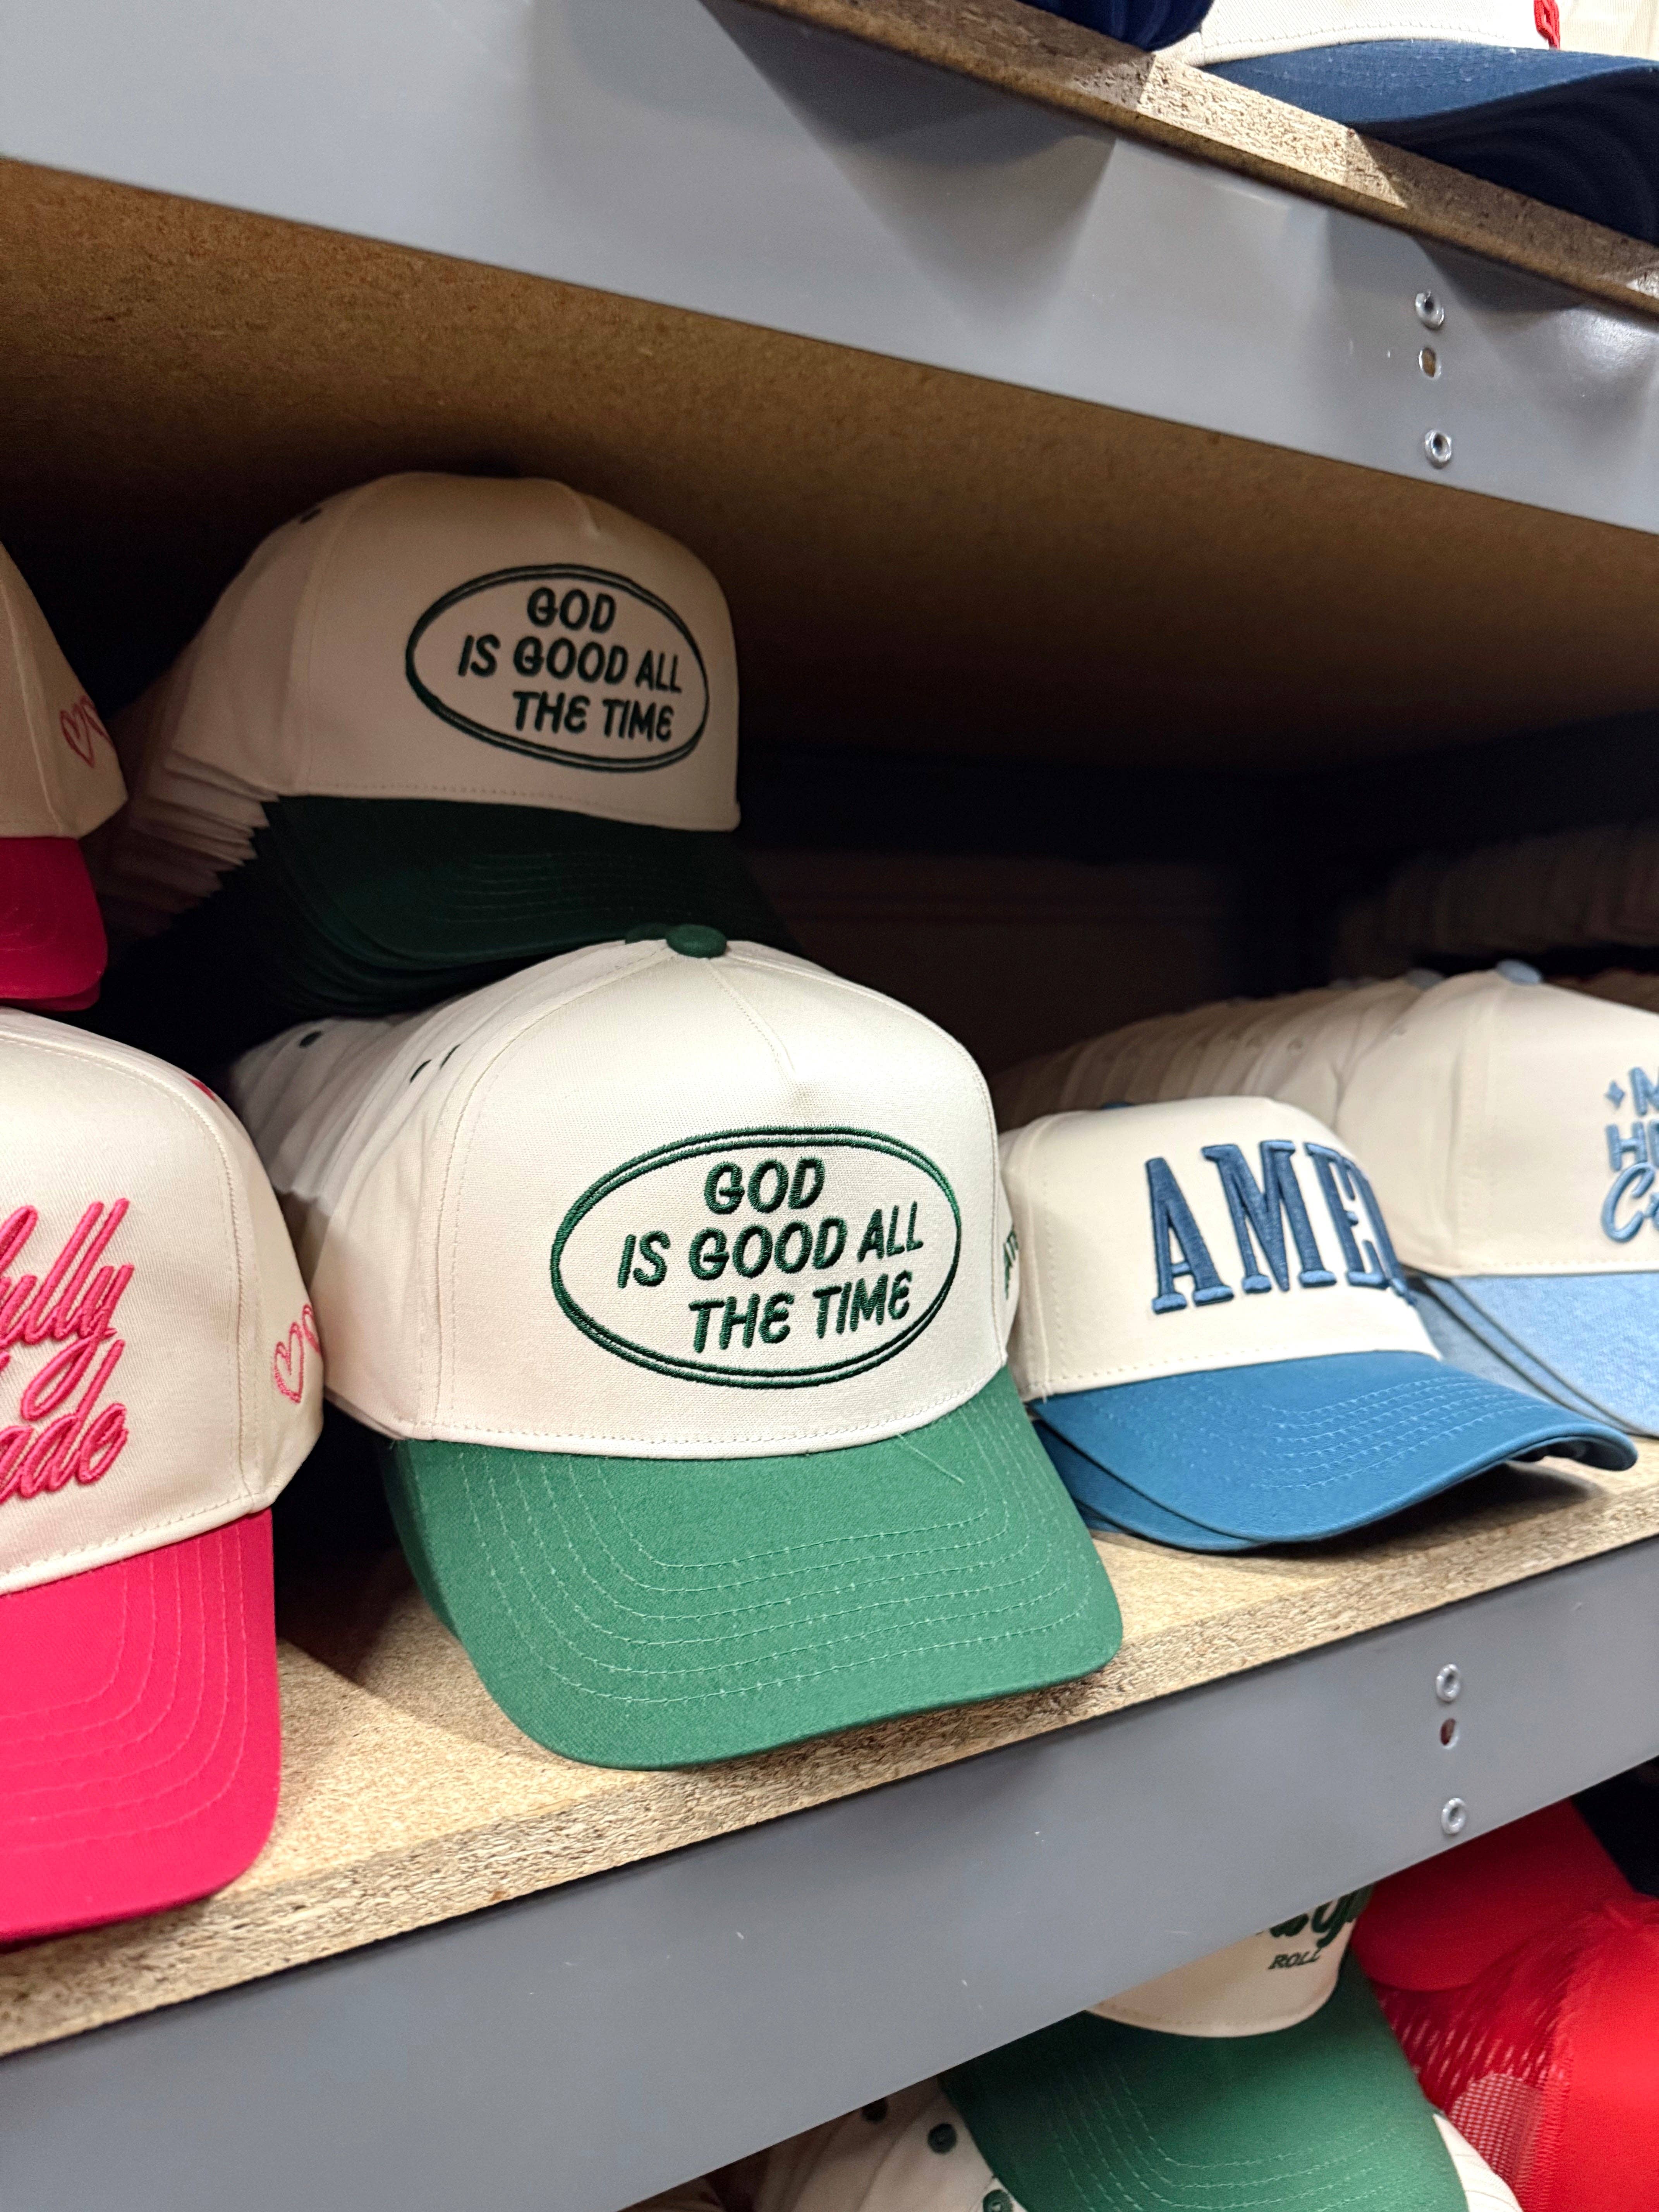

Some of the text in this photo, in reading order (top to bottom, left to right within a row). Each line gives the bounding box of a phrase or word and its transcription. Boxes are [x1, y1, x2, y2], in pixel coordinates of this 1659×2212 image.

[526, 586, 617, 634] GOD
[457, 634, 683, 694] IS GOOD ALL
[512, 690, 675, 742] THE TIME
[704, 1157, 826, 1216] GOD
[617, 1201, 924, 1289] IS GOOD ALL
[688, 1269, 913, 1354] THE TIME
